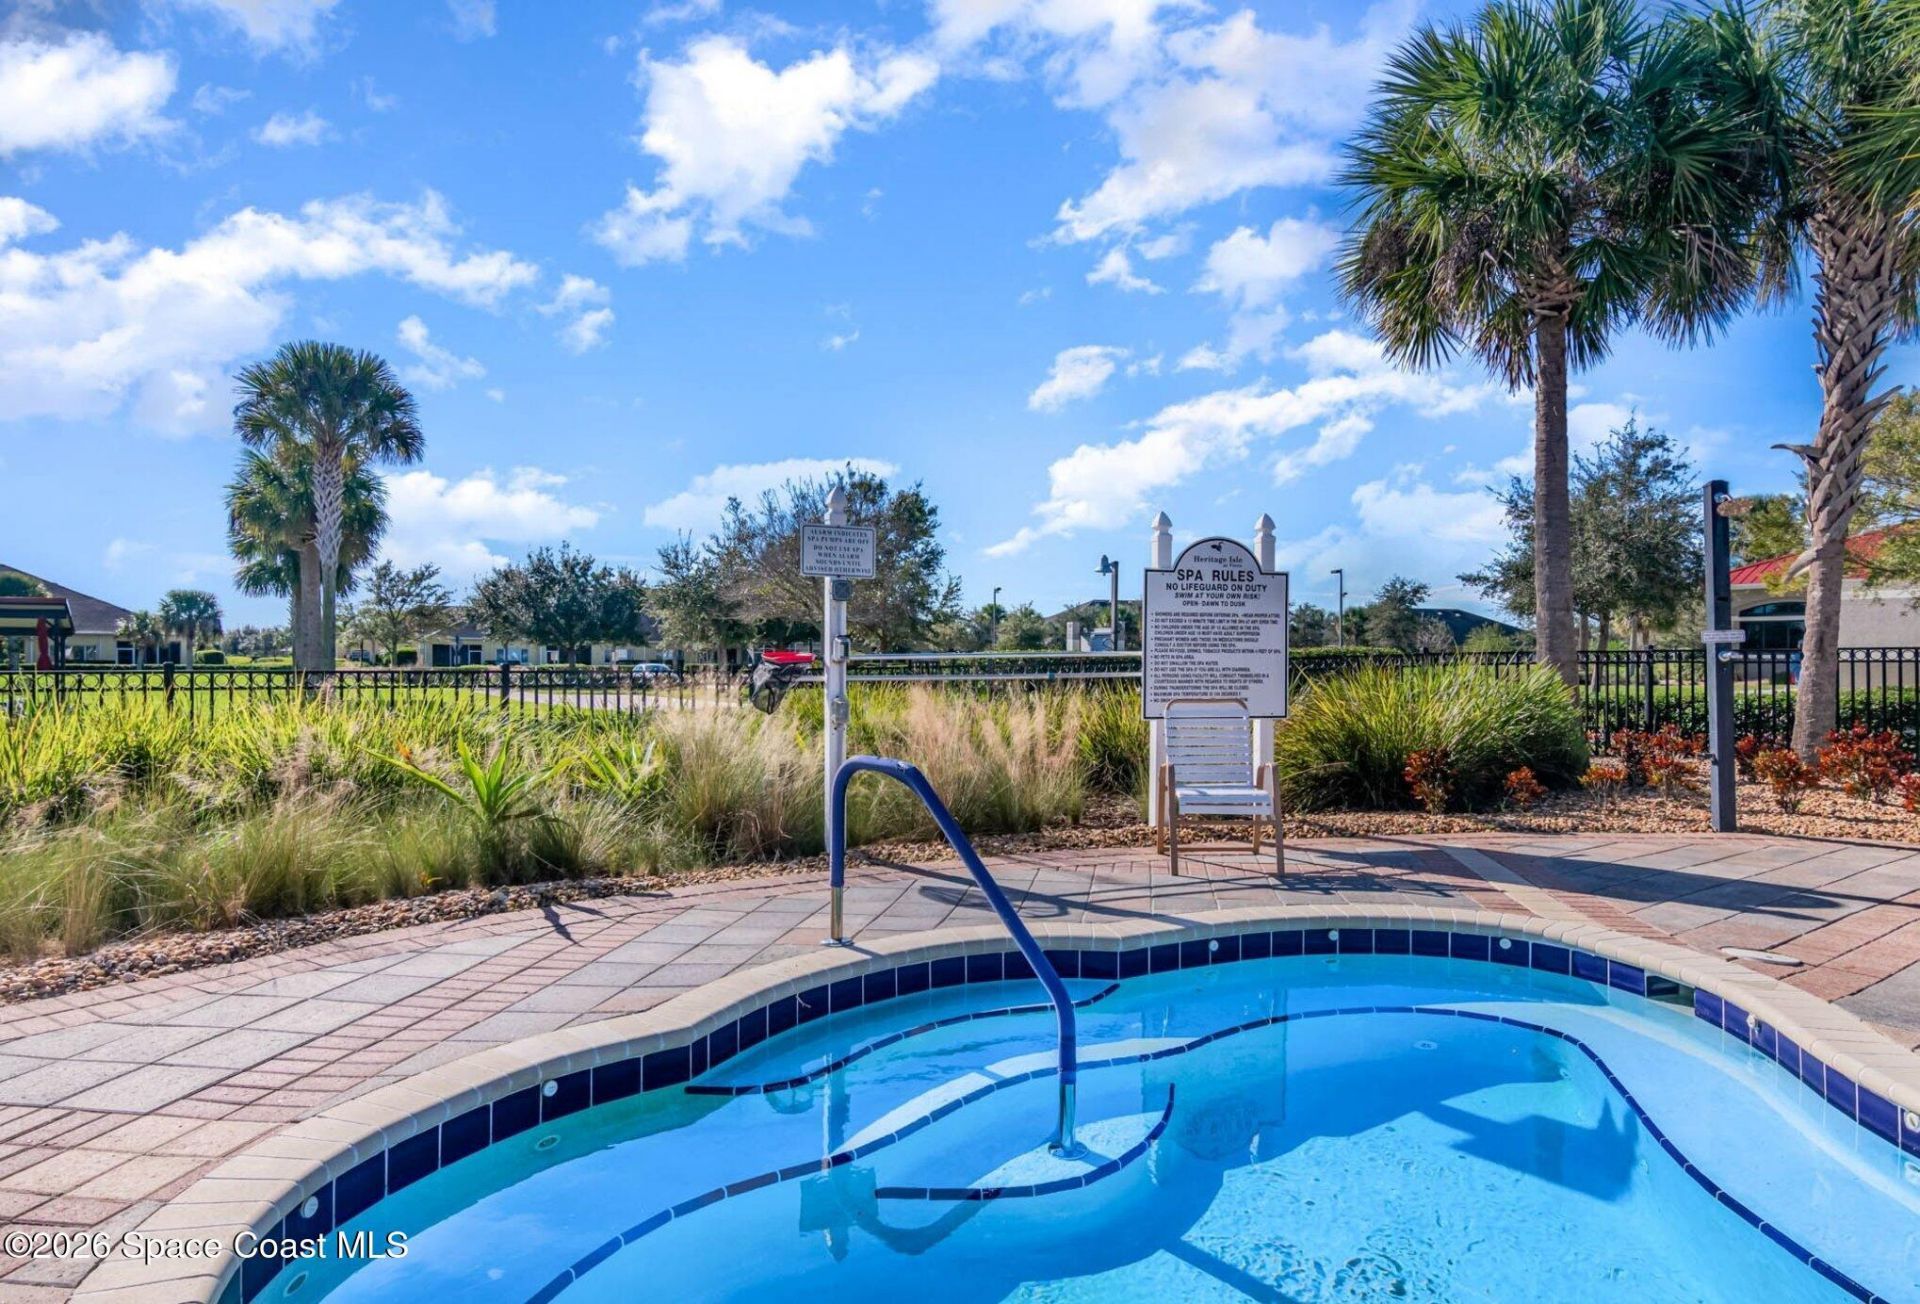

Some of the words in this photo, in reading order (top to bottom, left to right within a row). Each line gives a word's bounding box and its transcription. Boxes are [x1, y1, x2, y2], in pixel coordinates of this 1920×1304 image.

[1193, 555, 1227, 565] Heritage
[1229, 555, 1243, 563] Isle
[1177, 569, 1203, 581] SPA
[1212, 570, 1254, 582] RULES
[1166, 582, 1179, 591] NO
[1181, 583, 1228, 592] LIFEGUARD
[1231, 584, 1244, 592] ON
